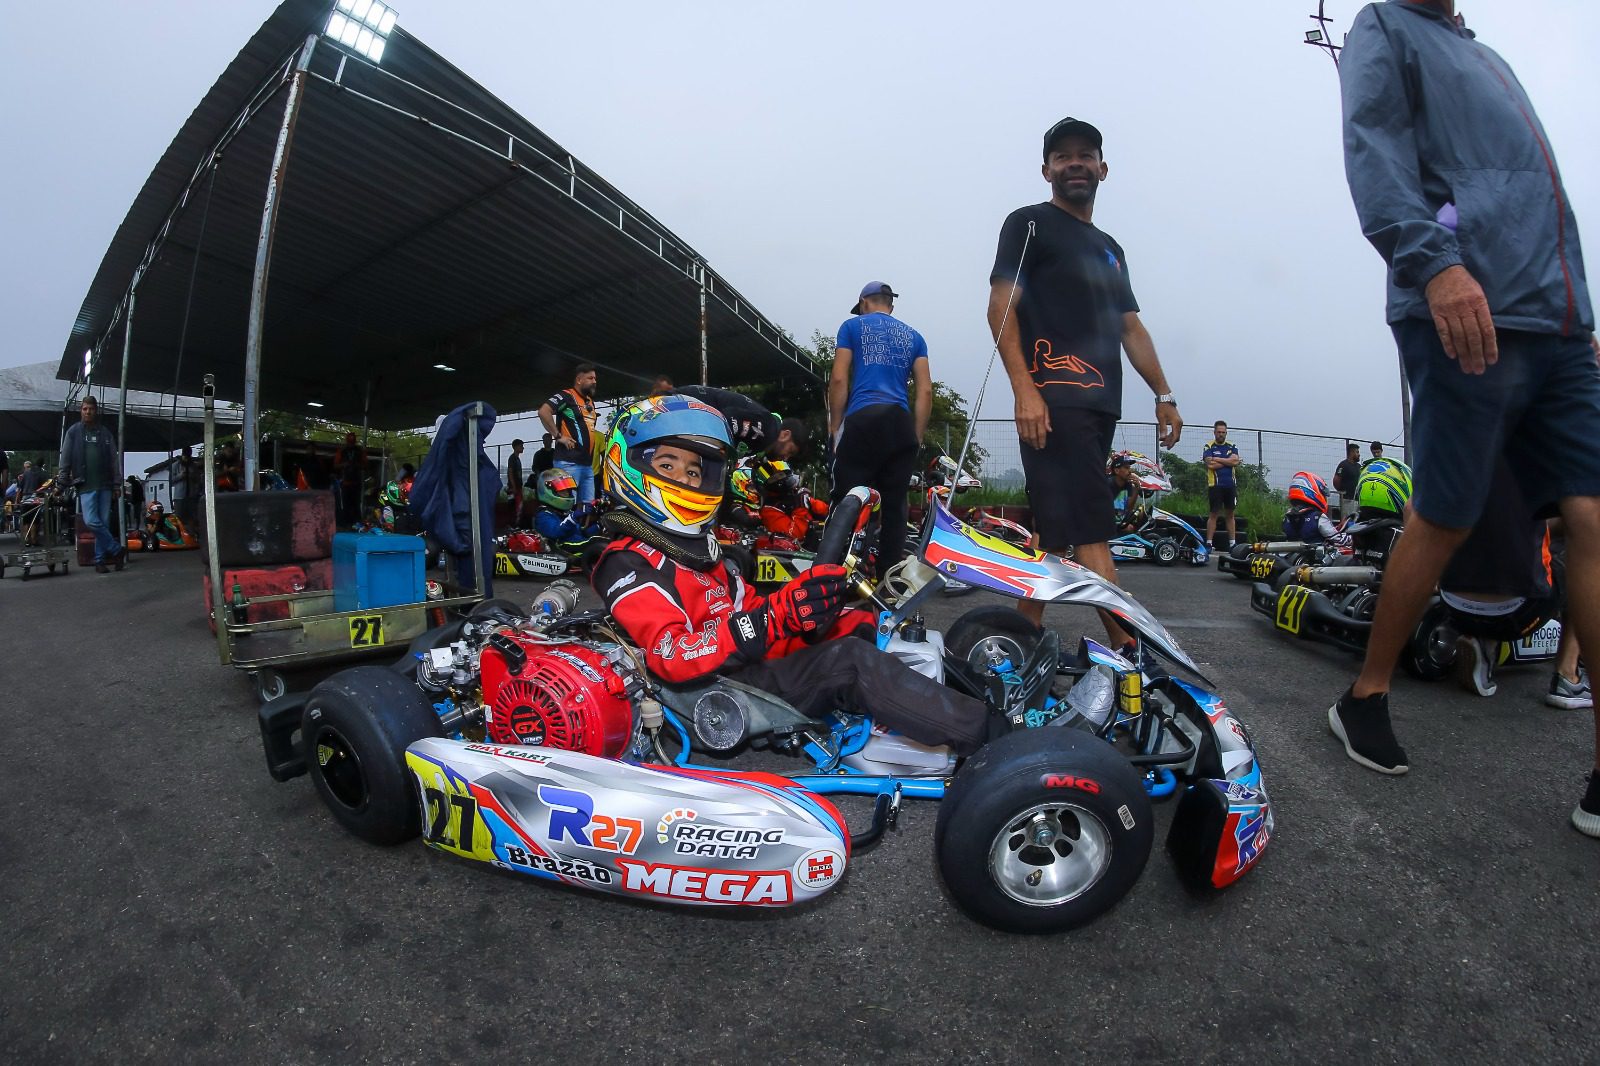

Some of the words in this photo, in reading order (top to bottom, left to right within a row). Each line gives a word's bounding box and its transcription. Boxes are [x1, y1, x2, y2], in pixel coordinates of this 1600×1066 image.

[496, 556, 508, 574] 26
[760, 559, 776, 580] 13
[1279, 585, 1309, 629] 21
[351, 617, 381, 645] 27
[738, 615, 755, 640] OMP
[514, 719, 543, 735] GX
[467, 743, 503, 755] MAX
[504, 750, 552, 761] KART
[1046, 774, 1100, 794] MG
[424, 787, 477, 853] 27
[675, 826, 783, 843] RACING
[677, 841, 758, 858] DATA
[504, 843, 612, 884] Brazão
[618, 862, 789, 902] MEGA
